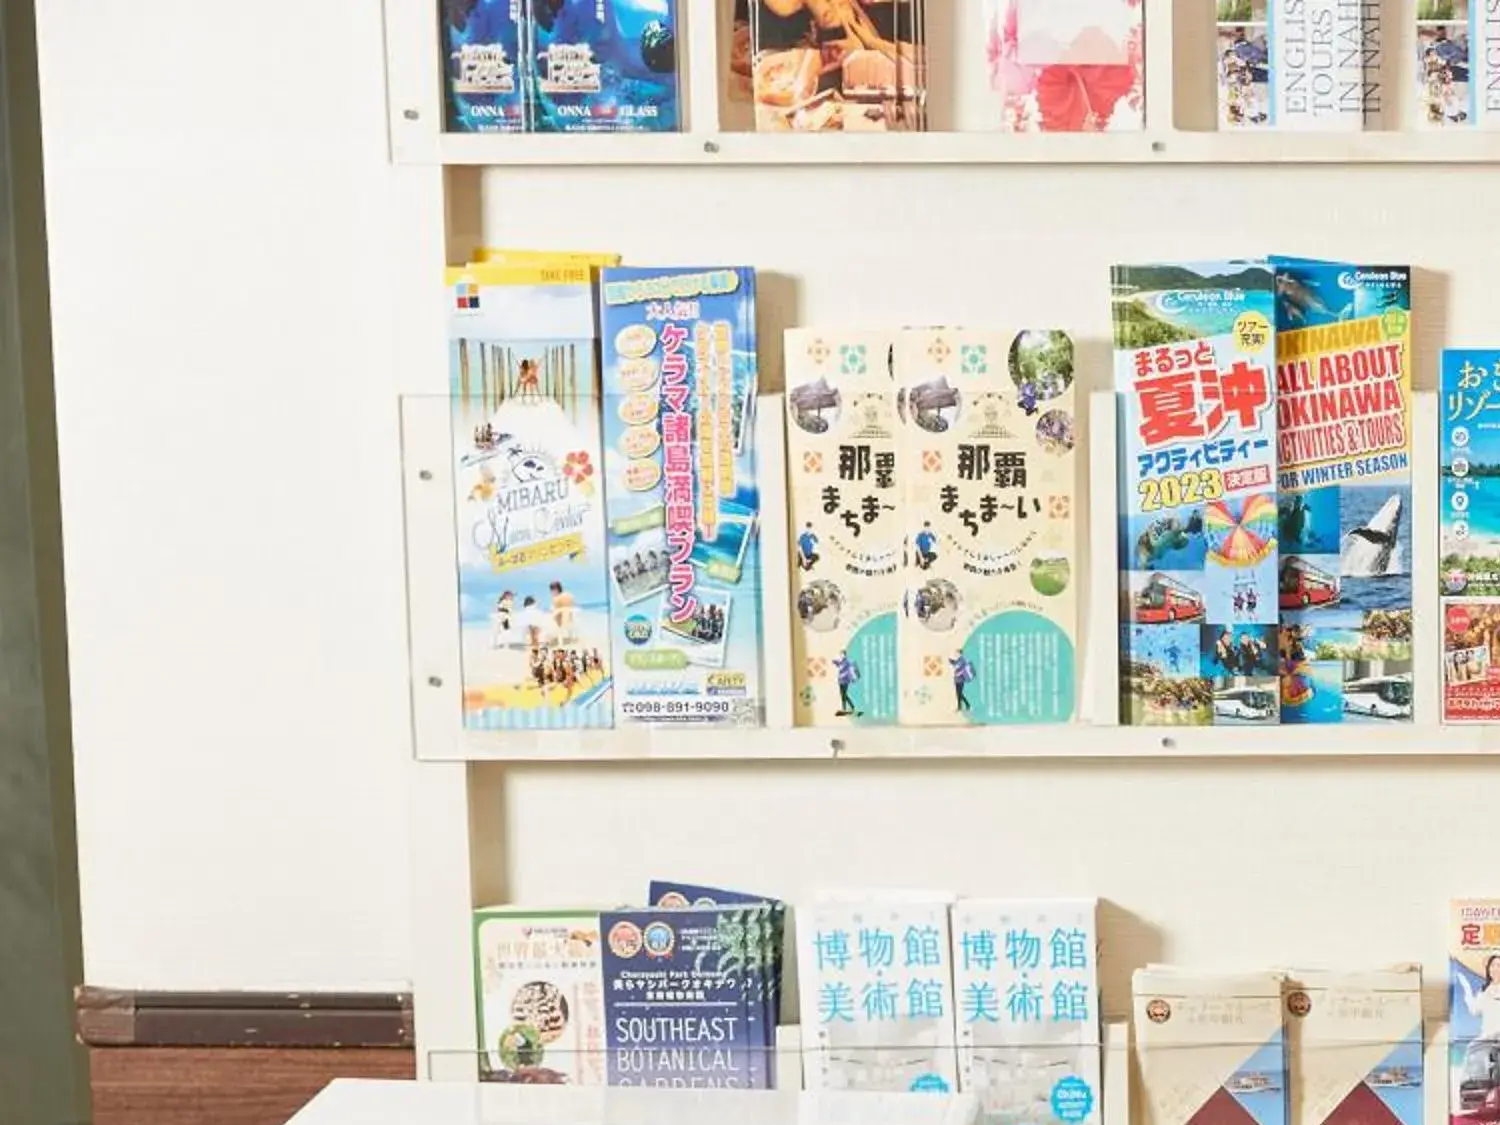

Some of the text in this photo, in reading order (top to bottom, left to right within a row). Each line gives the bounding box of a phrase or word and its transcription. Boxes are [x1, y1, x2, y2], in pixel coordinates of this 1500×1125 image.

[1312, 8, 1333, 115] TOURS
[557, 105, 591, 117] ONNA
[1134, 342, 1214, 376] まるっと
[1319, 344, 1402, 387] ABOUT
[1134, 361, 1269, 444] 夏沖
[957, 444, 1028, 488] 那覇
[1138, 439, 1269, 477] アクティビティー
[1278, 453, 1408, 489] OR WINTER SEASON
[1138, 468, 1223, 511] 2023
[812, 926, 940, 971] 博物館
[959, 927, 1088, 971] 博物館
[817, 979, 945, 1024] 美術館
[961, 980, 1089, 1024] 美術館
[615, 1016, 739, 1042] SOUTHEAST
[617, 1047, 741, 1073] BOTANICAL
